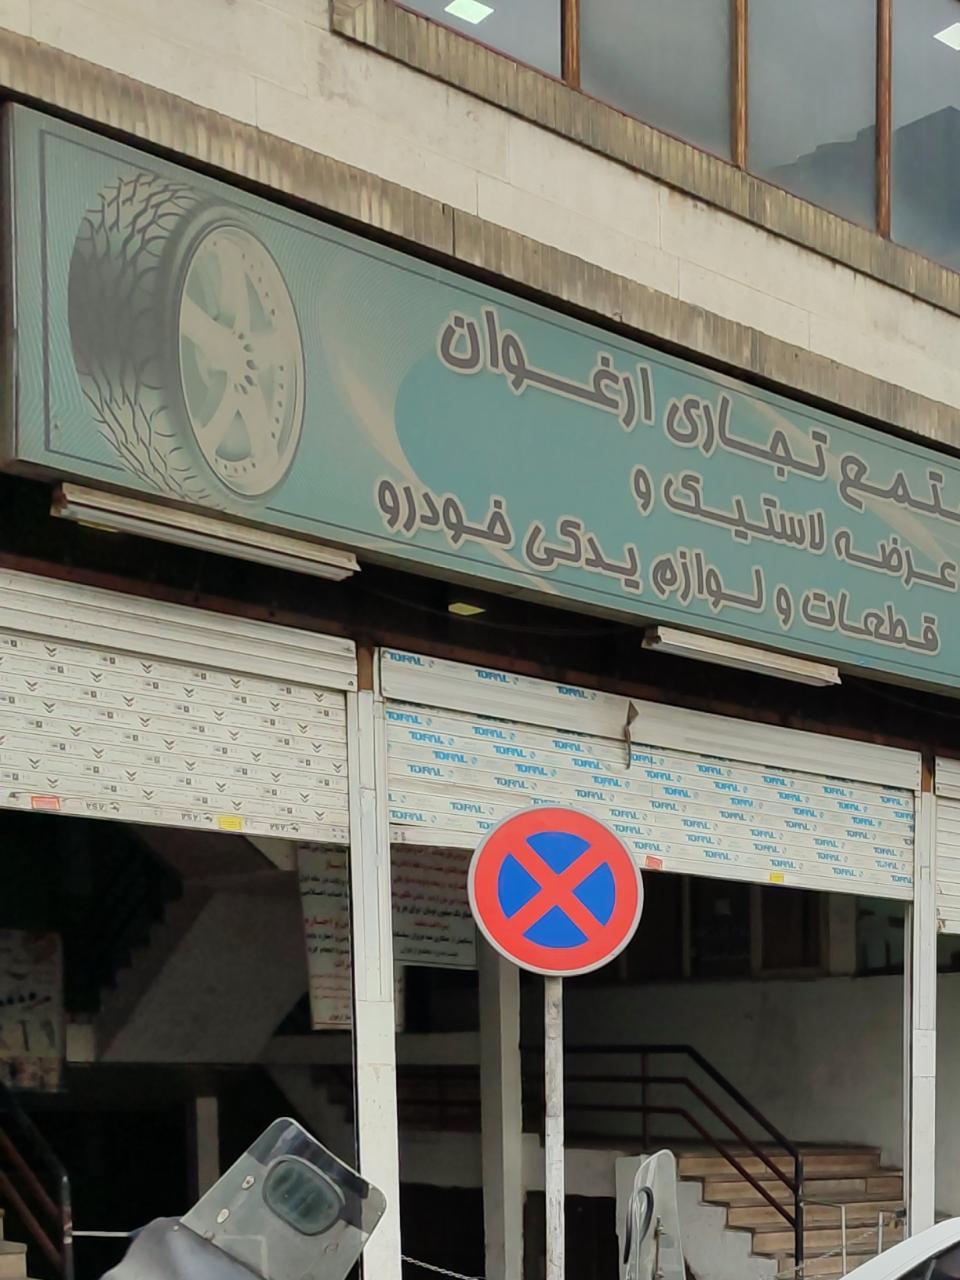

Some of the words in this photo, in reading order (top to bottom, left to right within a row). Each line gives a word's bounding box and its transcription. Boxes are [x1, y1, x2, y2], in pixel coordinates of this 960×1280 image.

[440, 311, 653, 427] ارغوان
[667, 397, 827, 478] تجاری
[377, 478, 513, 546] خودرو
[634, 468, 652, 512] و
[664, 471, 824, 553] لاستیک
[525, 519, 639, 595] یدکی
[837, 530, 956, 590] عرضه
[775, 586, 792, 627] و
[803, 590, 940, 655] قطعات
